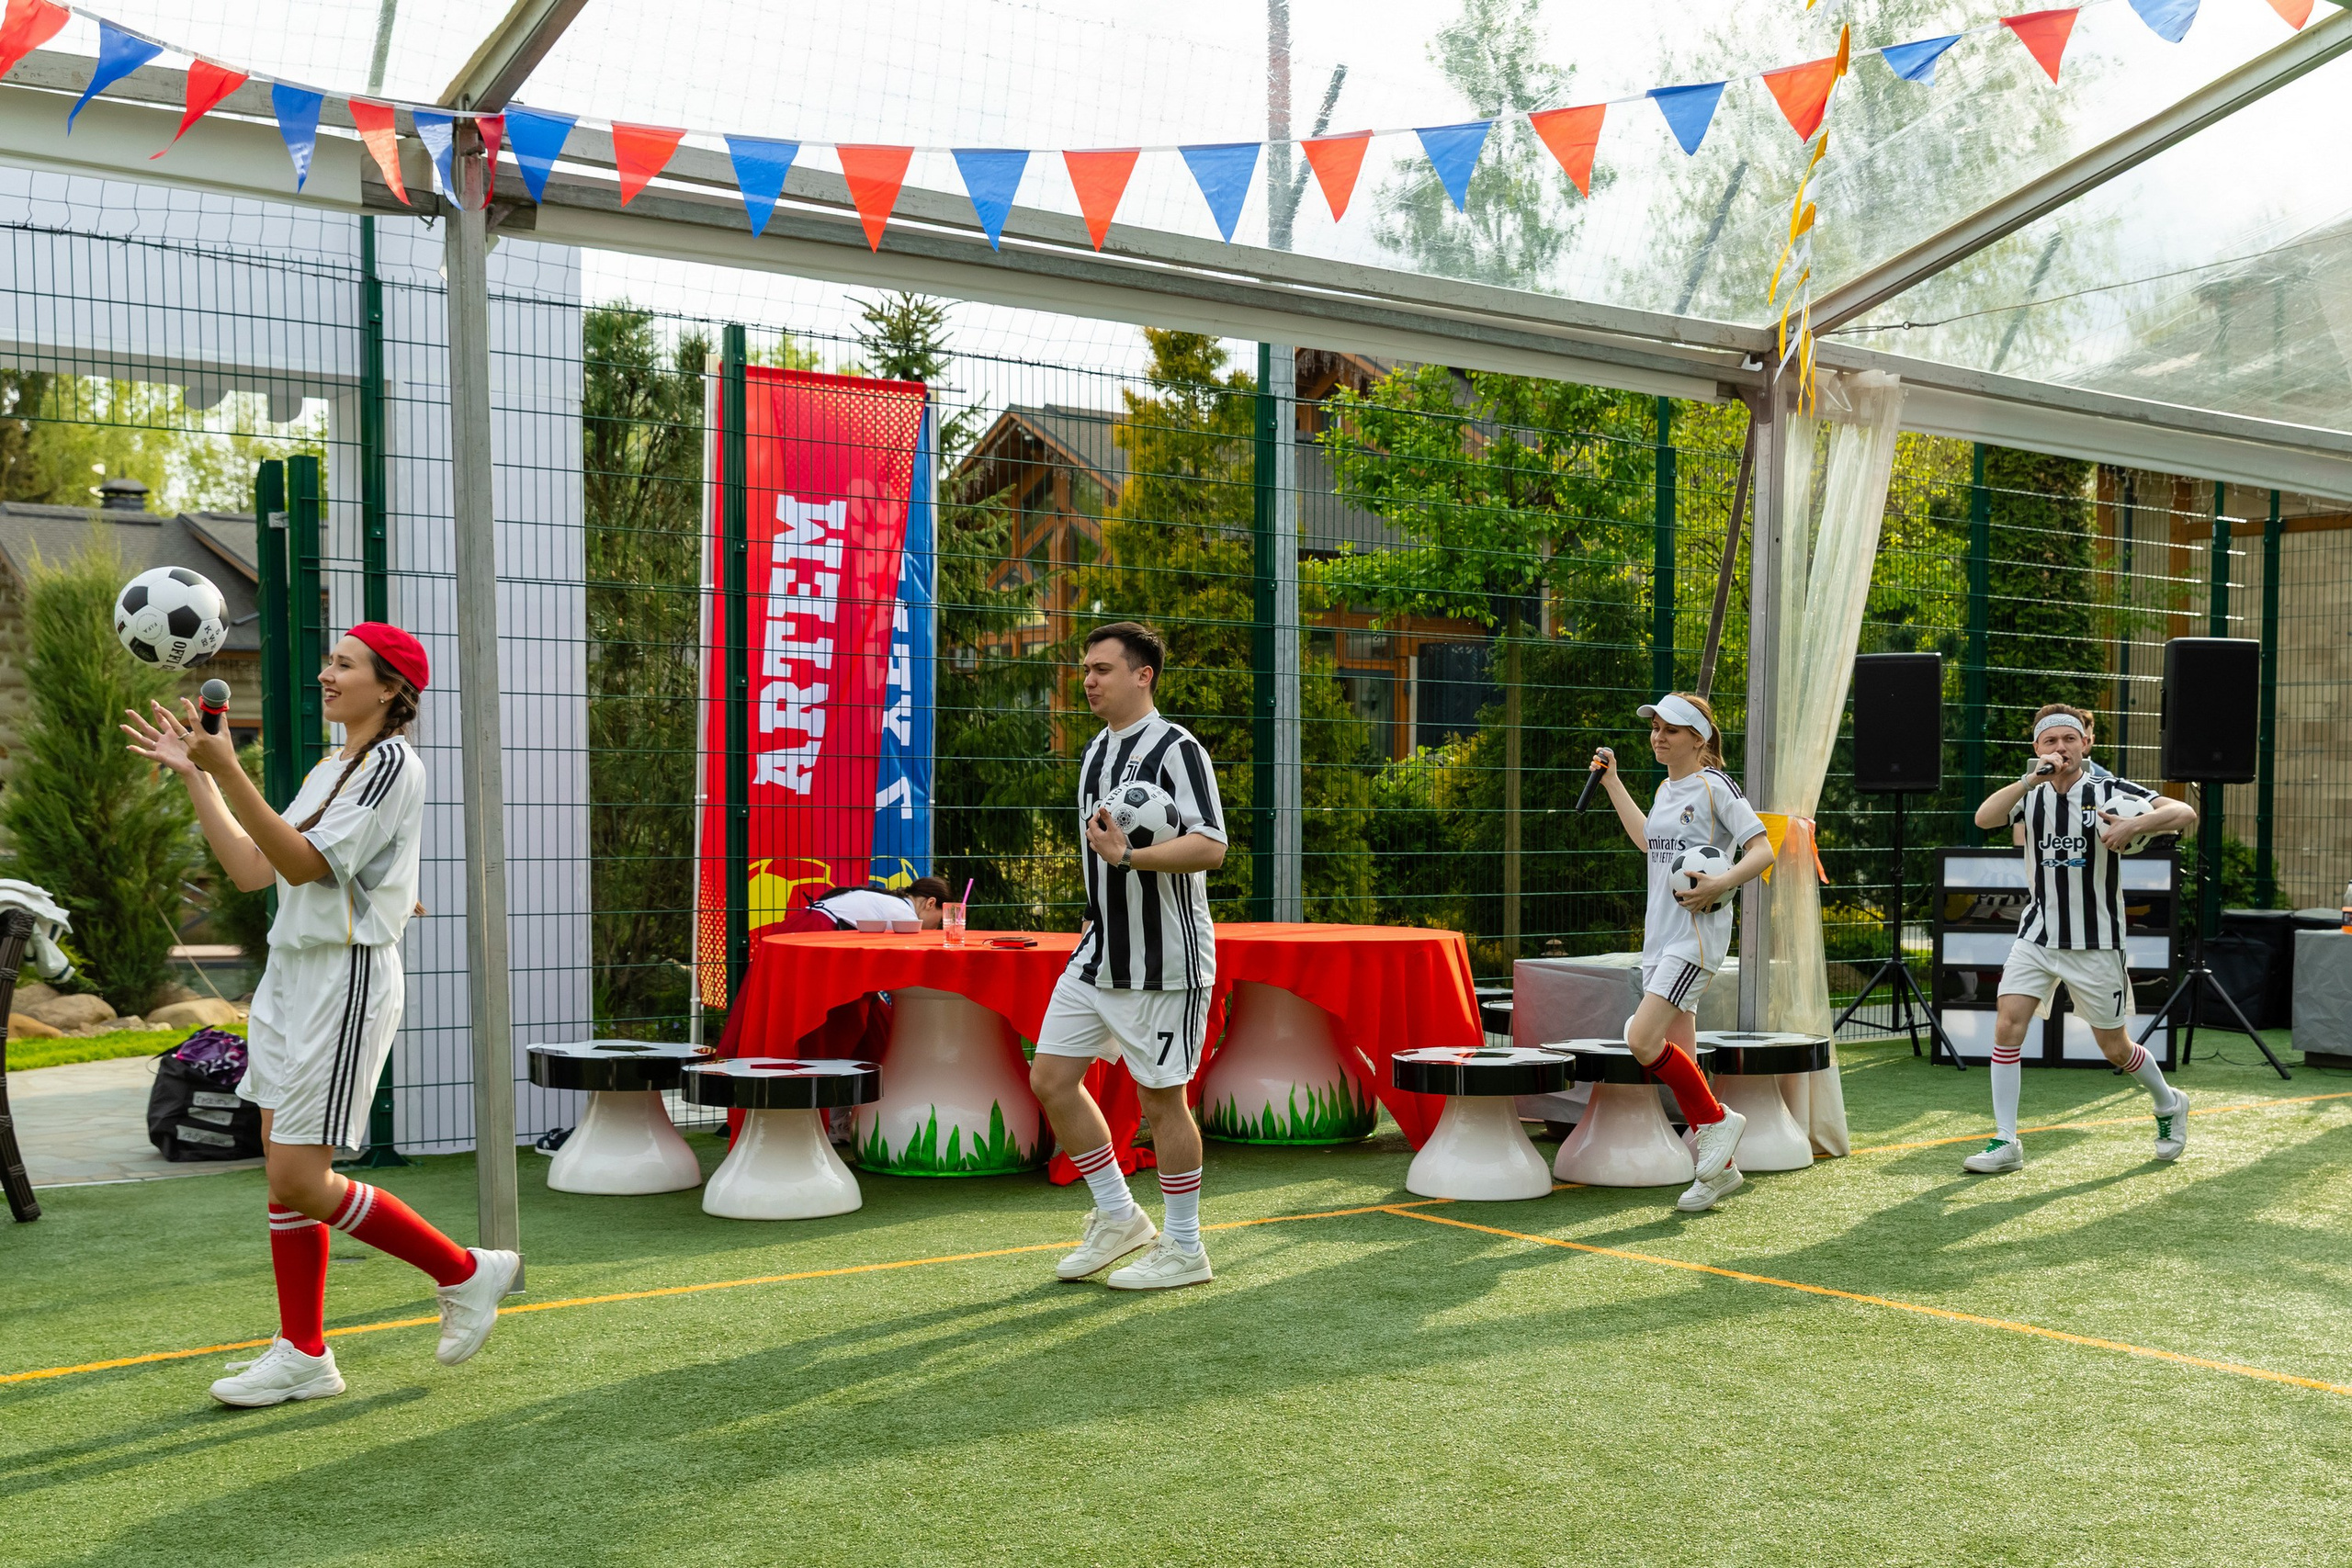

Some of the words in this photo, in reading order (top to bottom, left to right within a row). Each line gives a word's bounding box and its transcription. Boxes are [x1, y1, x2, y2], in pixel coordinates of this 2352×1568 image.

[752, 493, 847, 795] ARTEM
[1647, 835, 1686, 851] mirats
[2039, 832, 2087, 852] Jeep
[2113, 990, 2122, 1017] 7
[1157, 1032, 1174, 1066] 7
